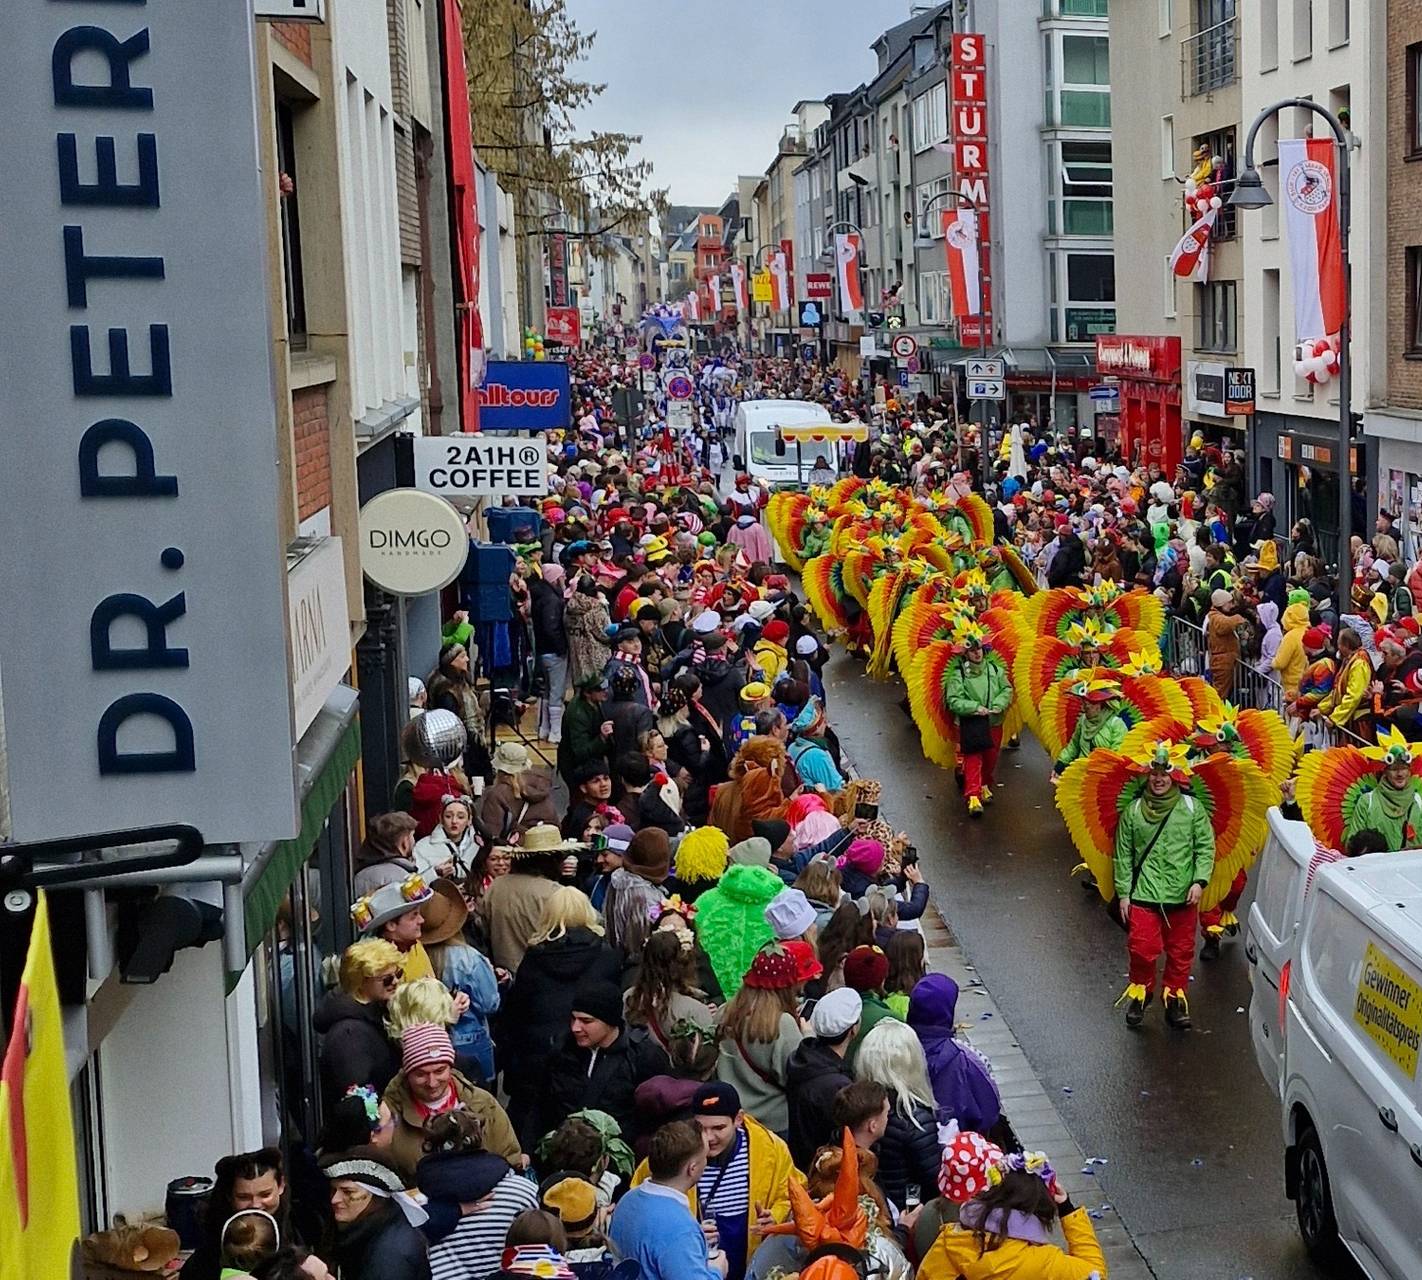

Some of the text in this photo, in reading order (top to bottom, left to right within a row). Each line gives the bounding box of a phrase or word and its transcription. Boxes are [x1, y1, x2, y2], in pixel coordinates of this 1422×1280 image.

[808, 282, 831, 290] REWE
[1228, 371, 1253, 385] NEXT
[51, 0, 197, 776] DR. PETER
[1228, 385, 1253, 399] DOOR
[429, 469, 541, 488] COFFEE
[369, 529, 451, 549] DIMGO
[1364, 962, 1412, 1012] Gewinner
[1357, 991, 1420, 1051] Originalitätspreis
